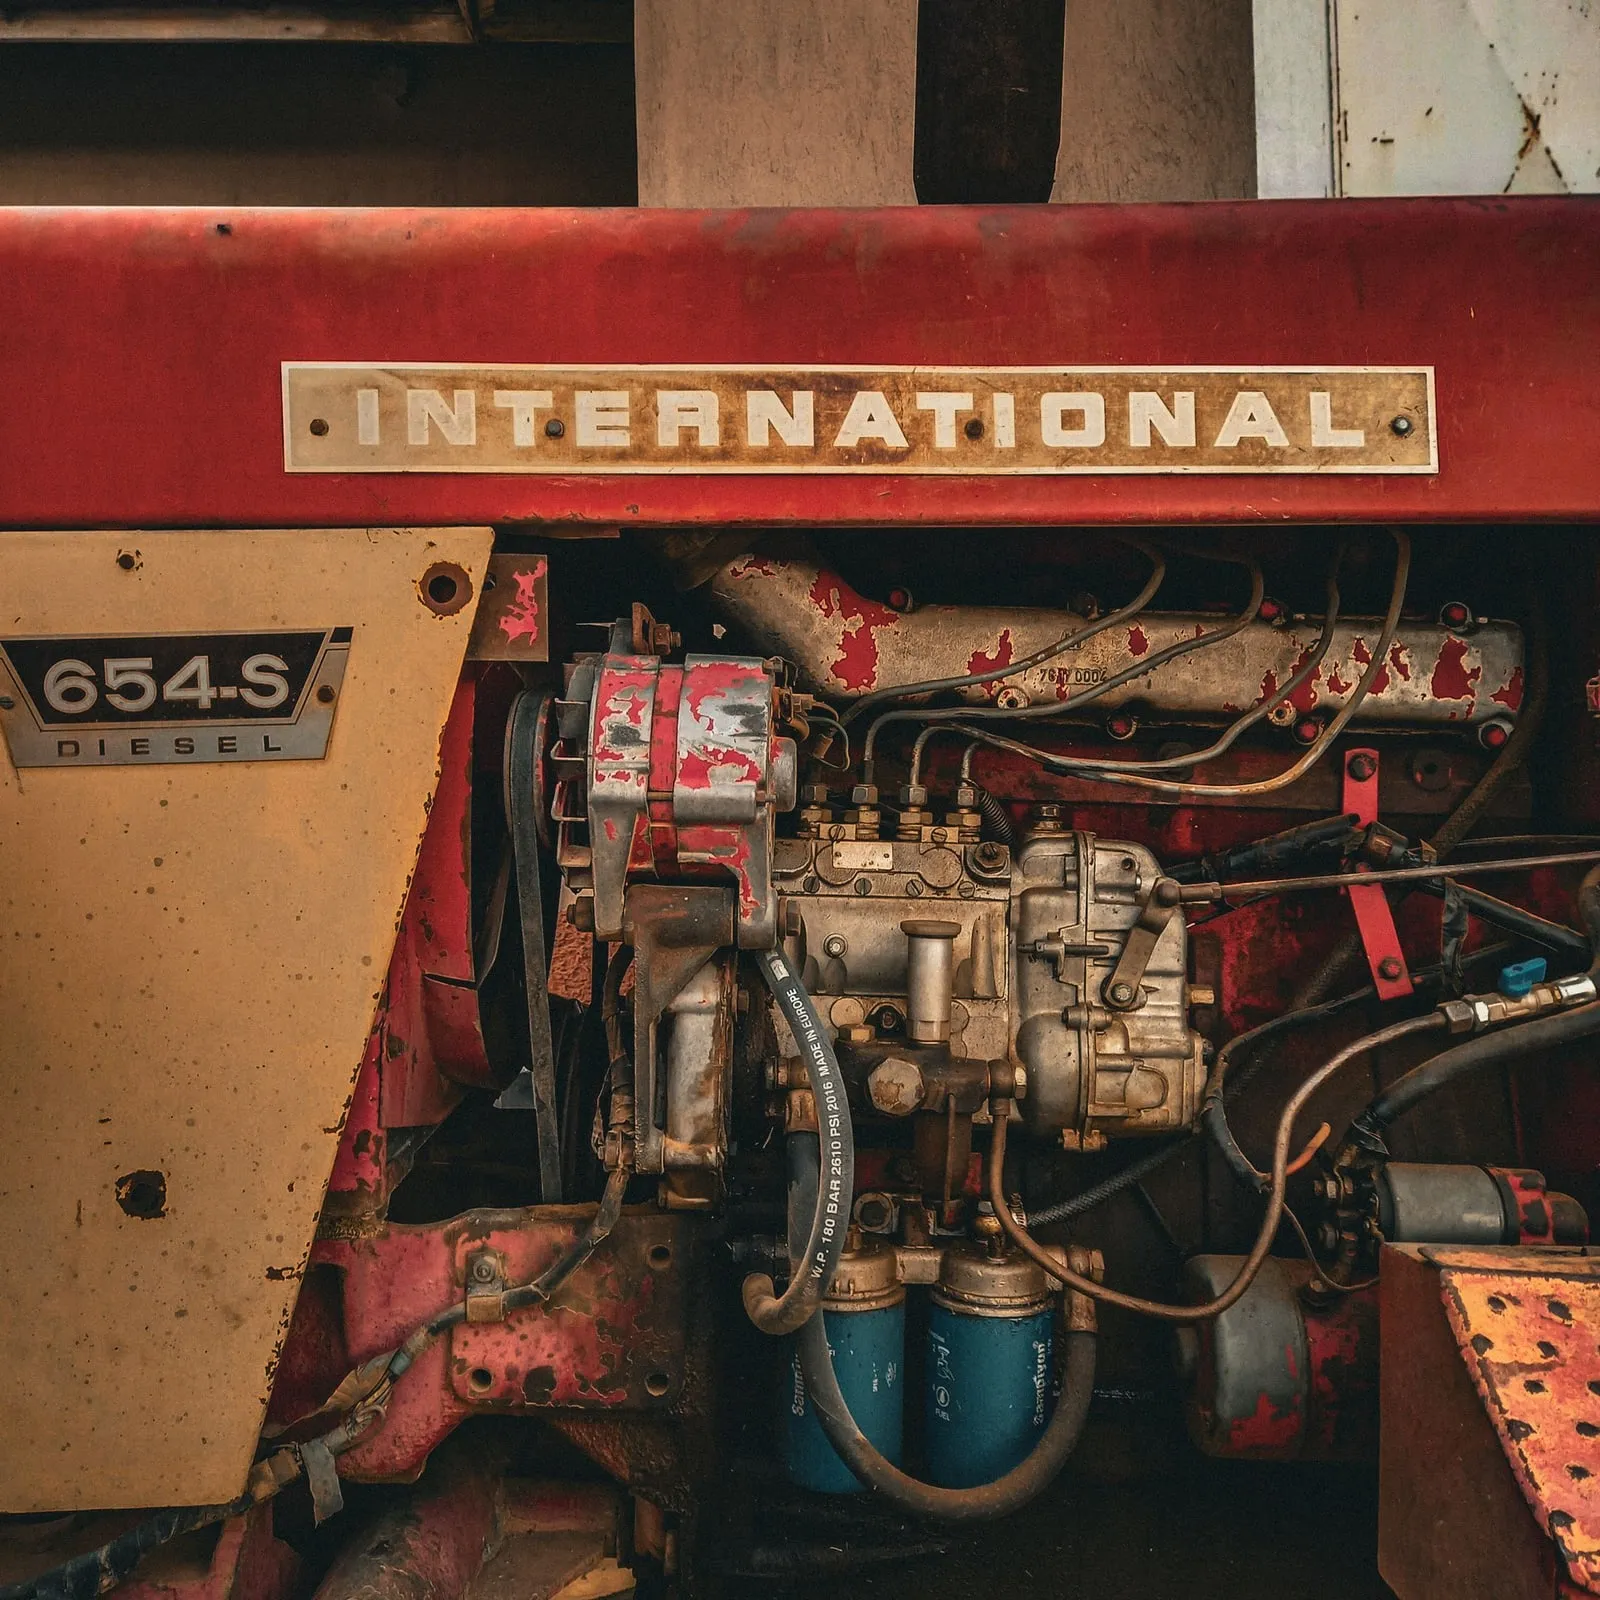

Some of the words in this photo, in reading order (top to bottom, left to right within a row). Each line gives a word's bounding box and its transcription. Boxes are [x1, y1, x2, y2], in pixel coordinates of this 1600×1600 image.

[355, 387, 1366, 451] INTERNATIONAL
[43, 653, 290, 714] 654-S
[56, 734, 282, 758] DIESEL
[786, 987, 813, 1029] EUROPE
[805, 1029, 818, 1043] IN
[810, 1042, 830, 1077] MADE
[822, 1081, 840, 1111] 2016
[828, 1114, 841, 1137] PSI
[830, 1140, 842, 1176] 2610
[827, 1179, 841, 1214] BAR
[821, 1218, 836, 1244] 180
[934, 1407, 951, 1422] FUEL
